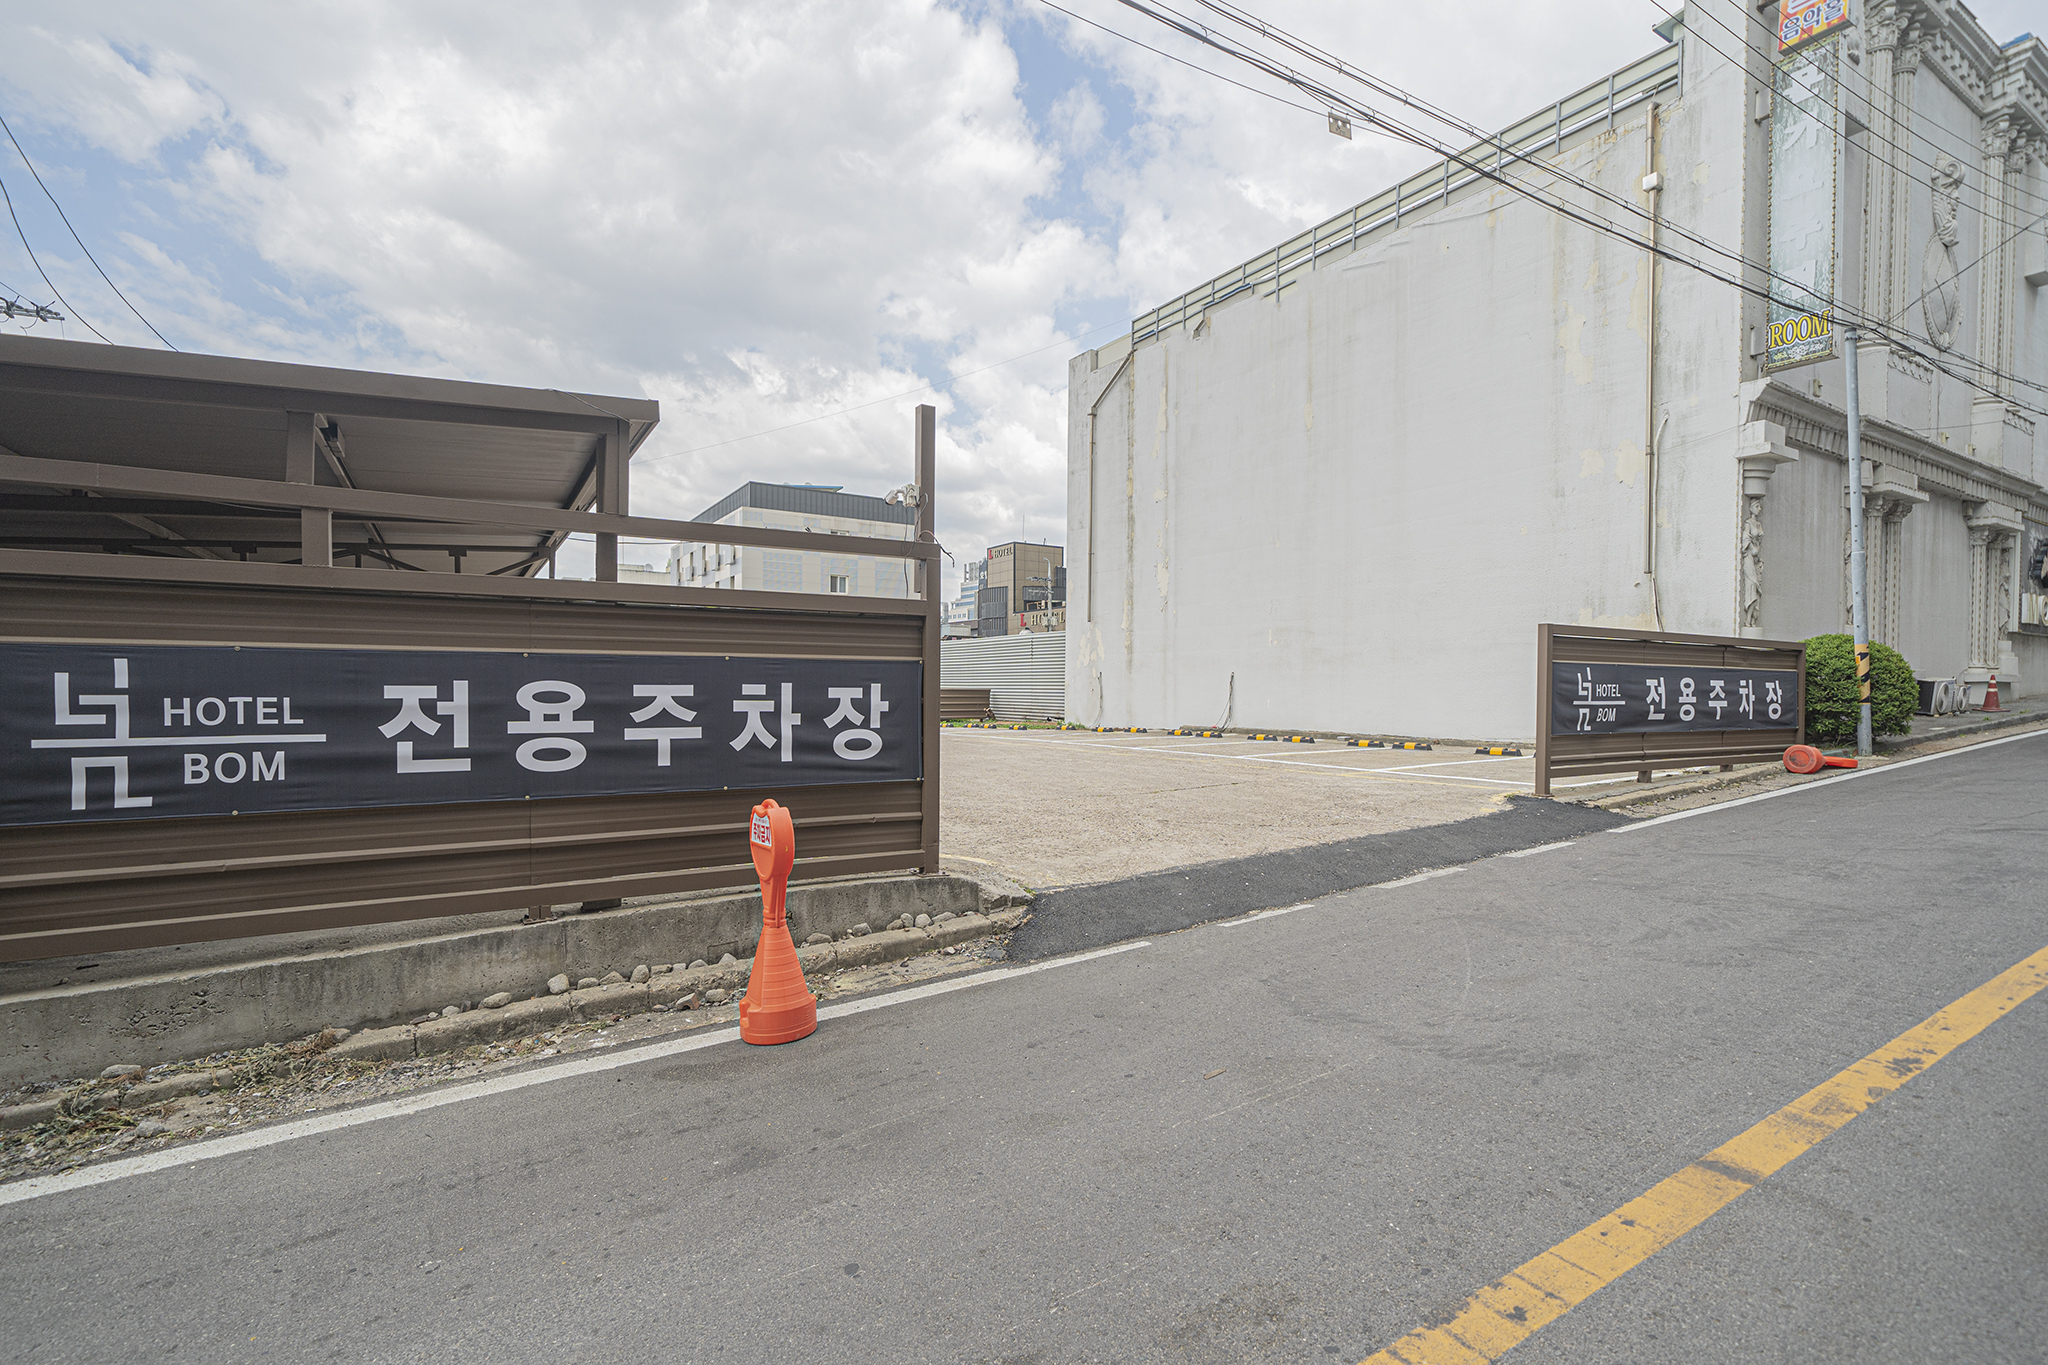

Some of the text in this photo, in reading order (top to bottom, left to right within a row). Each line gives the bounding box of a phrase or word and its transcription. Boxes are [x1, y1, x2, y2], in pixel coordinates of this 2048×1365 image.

[1769, 309, 1830, 348] ROOM
[994, 547, 1013, 559] HOTEL
[1020, 613, 1027, 627] L
[1596, 684, 1621, 697] HOTEL
[1646, 677, 1783, 722] 전용주차장
[163, 697, 304, 726] HOTEL
[1596, 708, 1616, 722] BOM
[377, 680, 889, 773] 전용주차장
[184, 751, 285, 784] BOM
[753, 822, 771, 845] 주차금지
